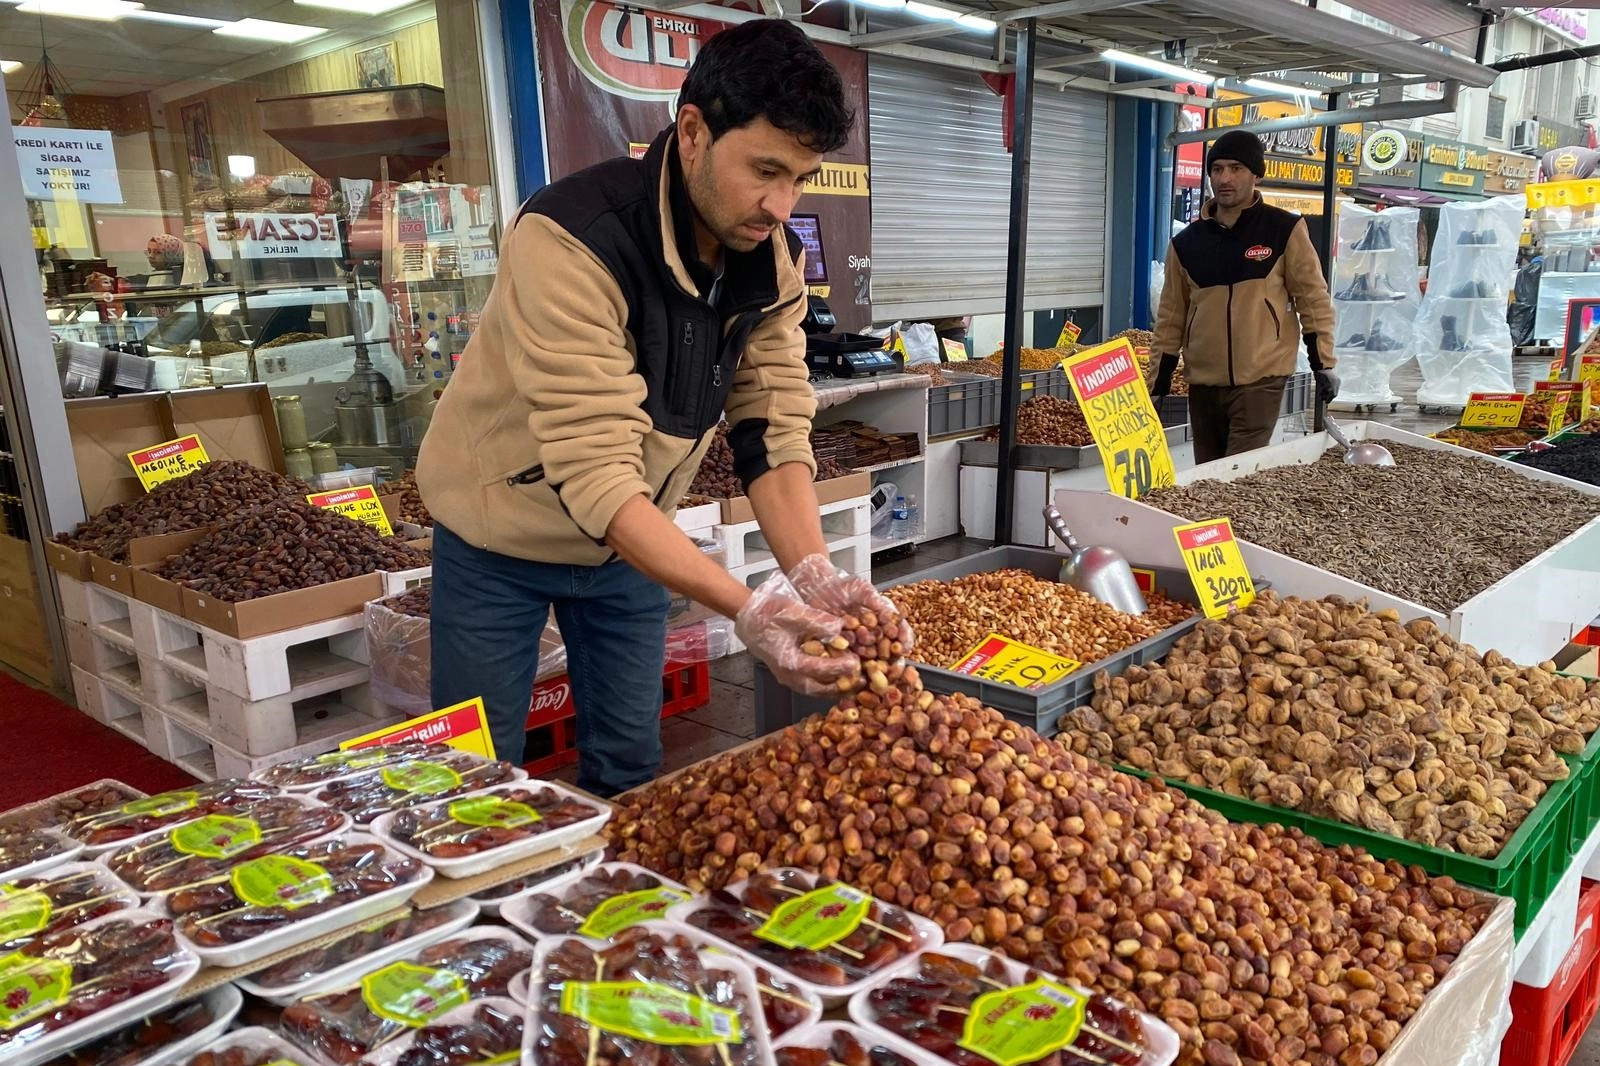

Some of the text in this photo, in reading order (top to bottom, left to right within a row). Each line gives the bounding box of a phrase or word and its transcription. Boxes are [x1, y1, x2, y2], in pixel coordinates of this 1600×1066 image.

[50, 140, 83, 149] KARTI
[86, 141, 104, 151] İLE
[40, 154, 82, 163] SİGARA
[35, 167, 91, 177] SATIŞIMIZ
[41, 181, 91, 191] YOKTUR!
[848, 255, 871, 271] Siyah
[1081, 354, 1129, 392] İNDİRİM
[1468, 412, 1498, 421] 150
[1113, 447, 1152, 499] 70
